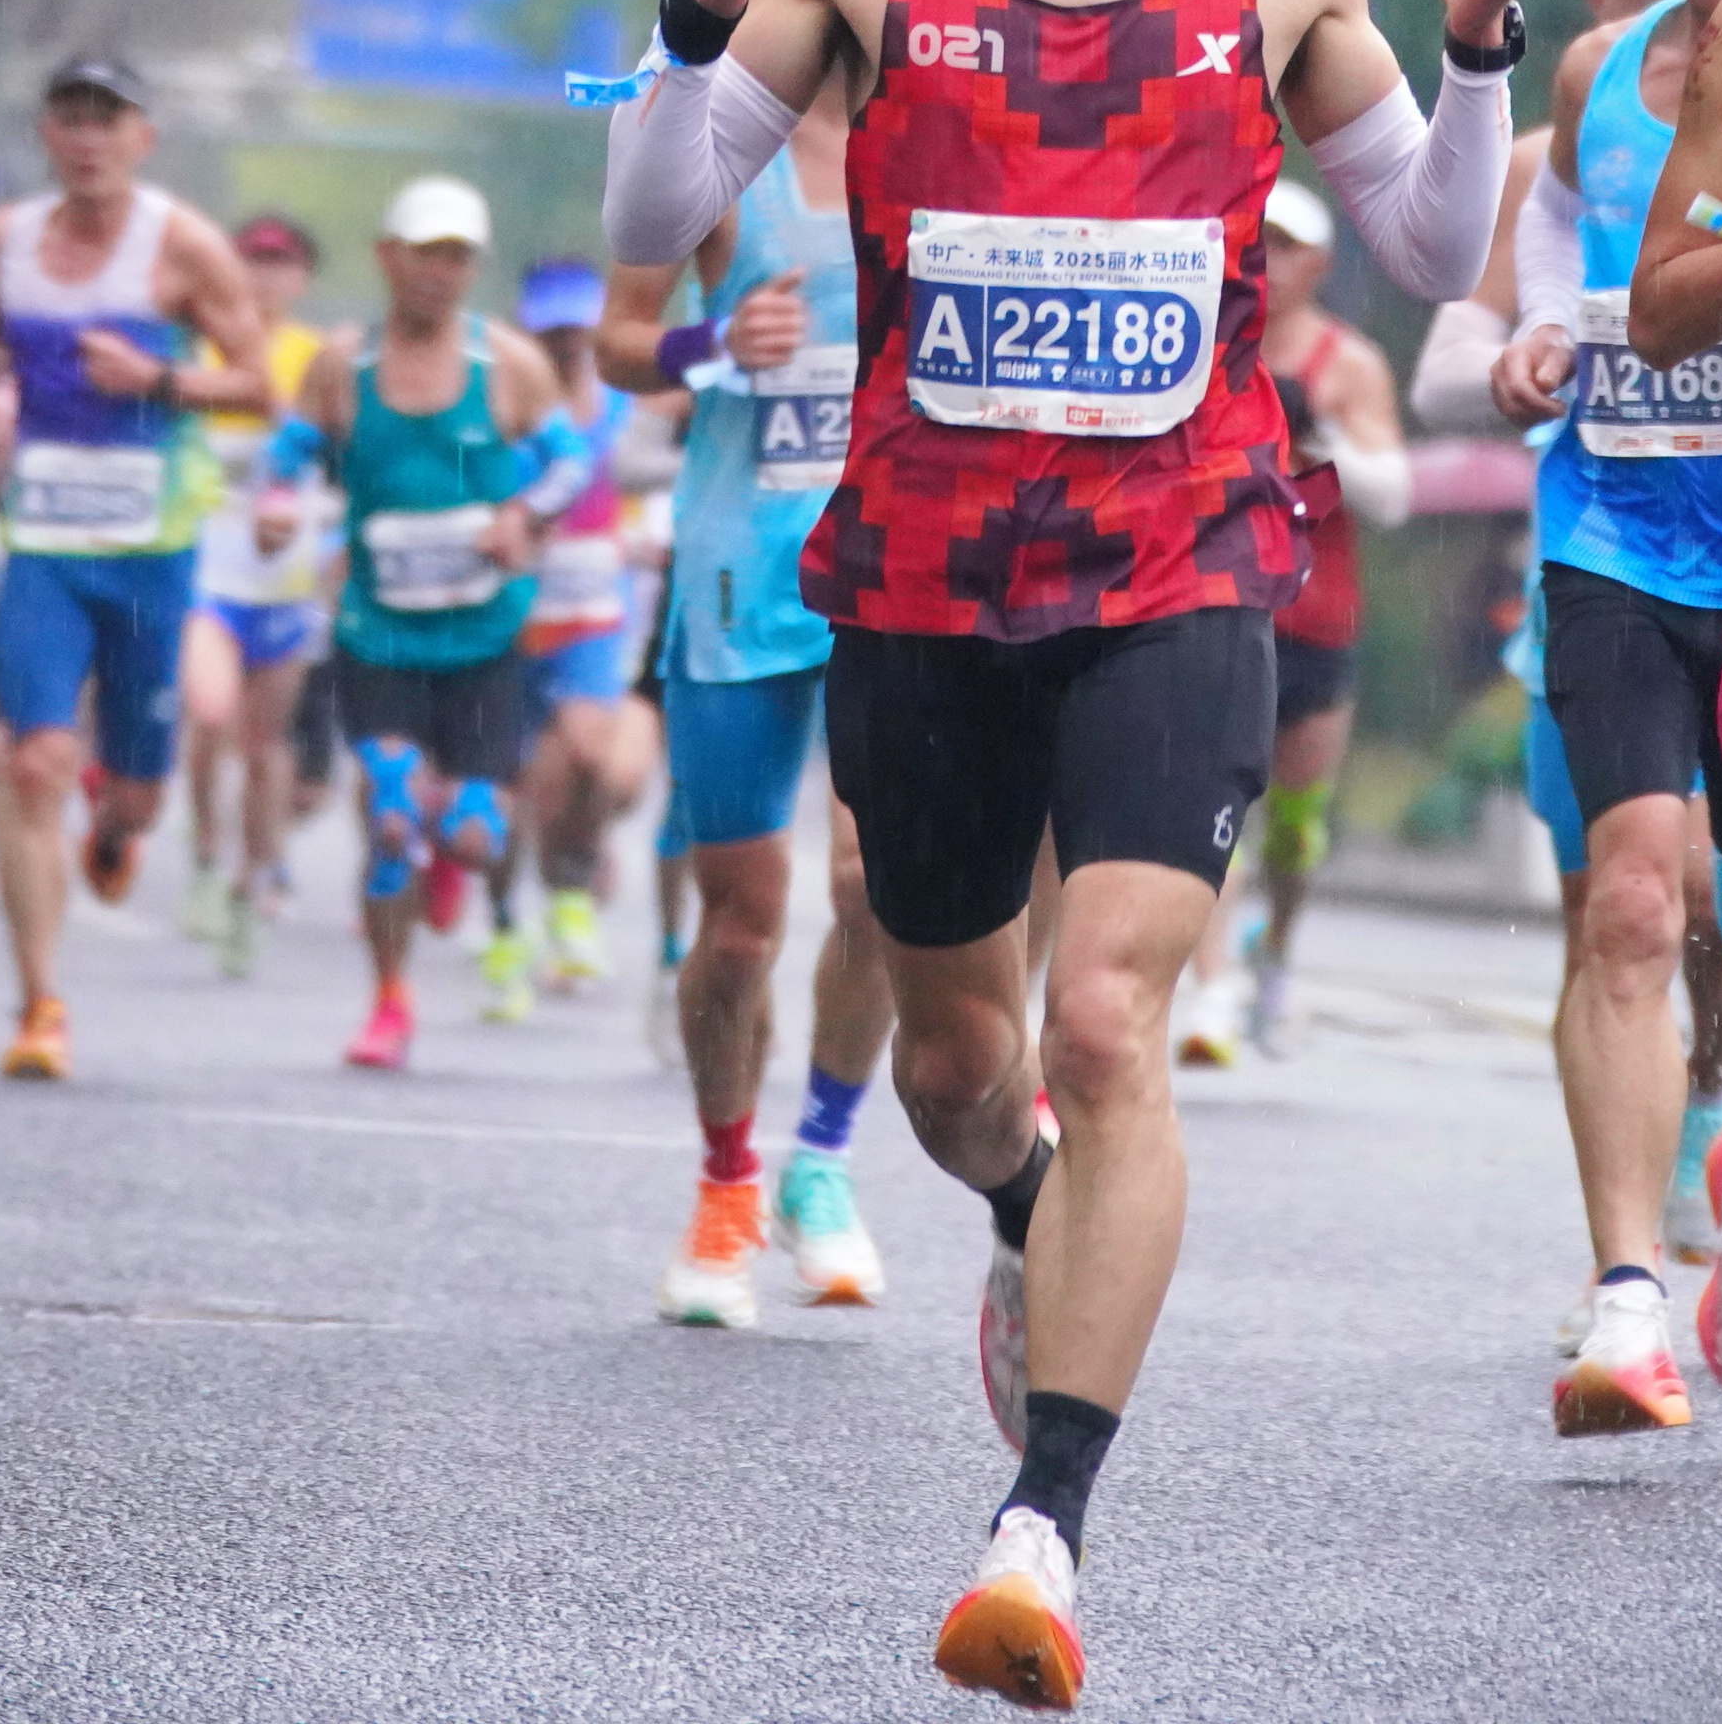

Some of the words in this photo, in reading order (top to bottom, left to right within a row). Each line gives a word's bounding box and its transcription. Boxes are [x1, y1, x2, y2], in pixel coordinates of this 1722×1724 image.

[908, 23, 1005, 73] 021
[1006, 270, 1049, 282] FUTURE
[1150, 274, 1208, 284] MARATHON
[1054, 250, 1208, 271] 2025丽水马拉松
[918, 295, 973, 365] A
[993, 297, 1186, 366] 22188
[763, 402, 806, 450] A
[815, 401, 851, 442] 2
